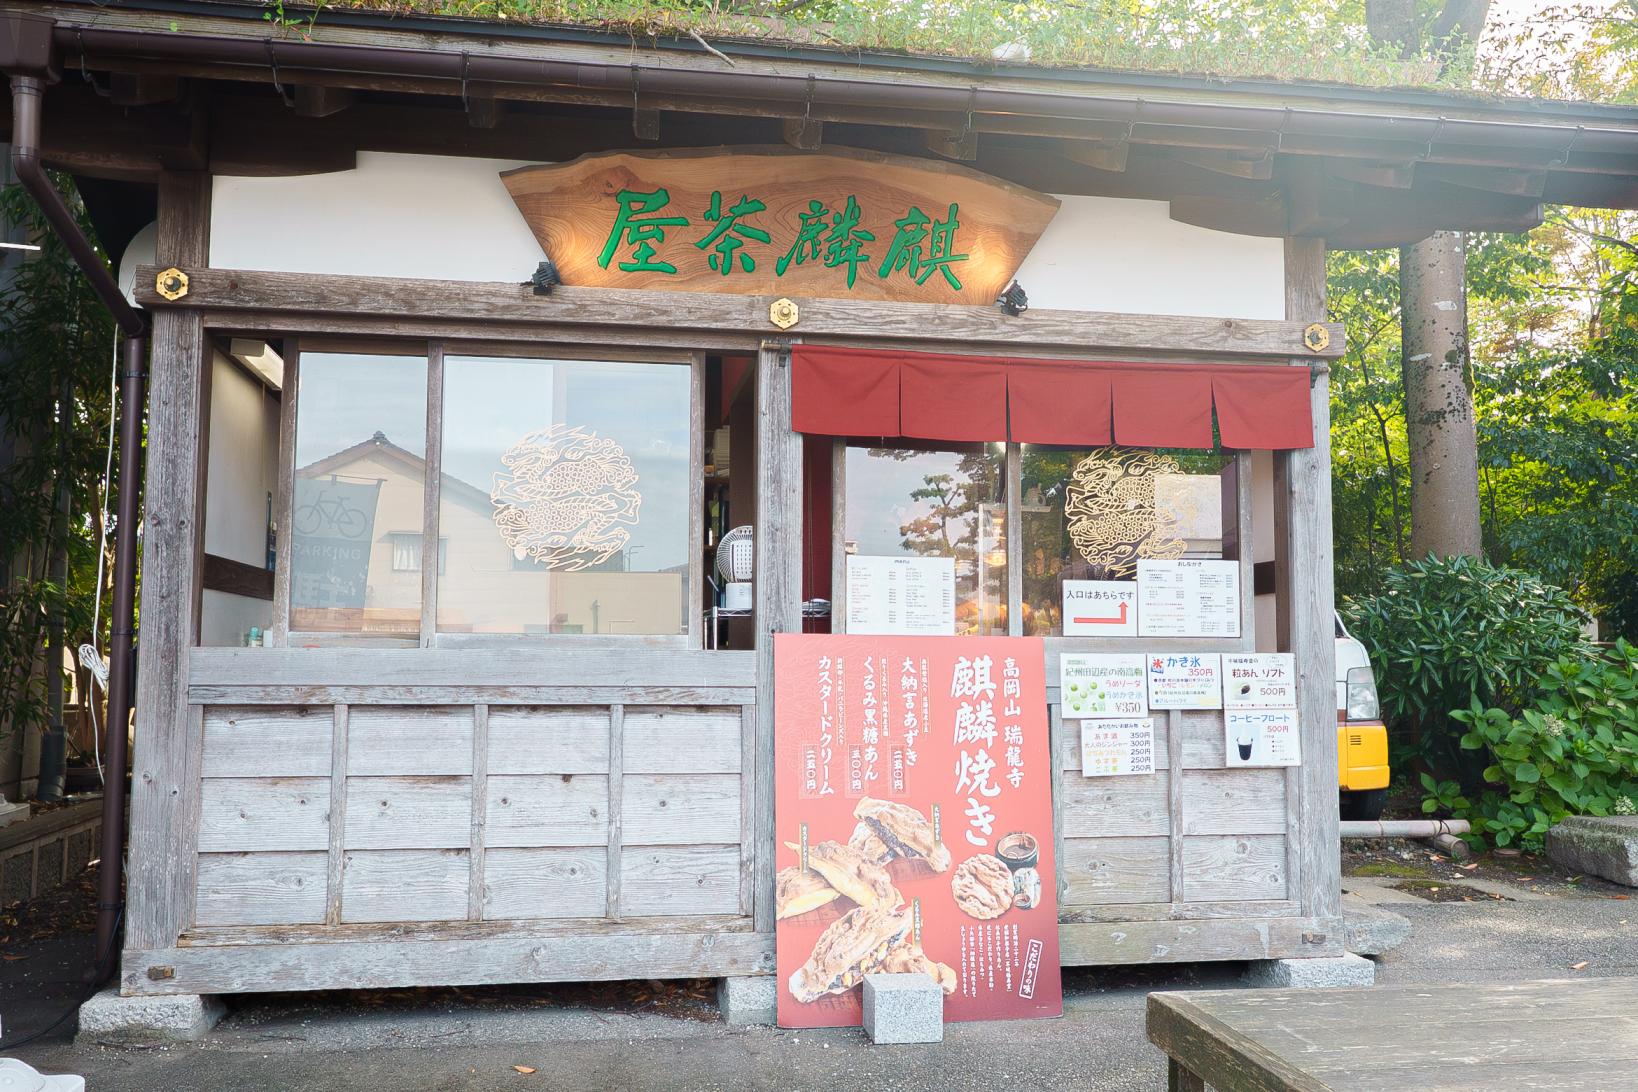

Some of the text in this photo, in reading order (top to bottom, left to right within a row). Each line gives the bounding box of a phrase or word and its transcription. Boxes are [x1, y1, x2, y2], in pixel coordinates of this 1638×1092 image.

[1066, 590, 1134, 600] 入口はあちらです
[1167, 655, 1201, 668] かき氷
[1187, 668, 1213, 677] 350円
[1232, 668, 1285, 678] 粒あん ソフト
[1260, 687, 1286, 696] 500円
[901, 656, 919, 767] 大納言あずき
[1114, 701, 1141, 713] ¥350
[863, 656, 879, 781] くるみ黒糖あん
[1002, 656, 1025, 788] 高岡山 瑞龍寺
[1230, 713, 1290, 723] コーヒーフロート
[818, 656, 834, 795] カスタードクリーム
[1267, 725, 1289, 733] 500円
[1129, 731, 1151, 739] 350円
[950, 654, 1001, 847] 麒麟焼き
[1130, 748, 1151, 756] 250円
[1130, 756, 1151, 764] 250円
[1130, 764, 1152, 772] 250円
[1022, 943, 1039, 995] こだわりの味
